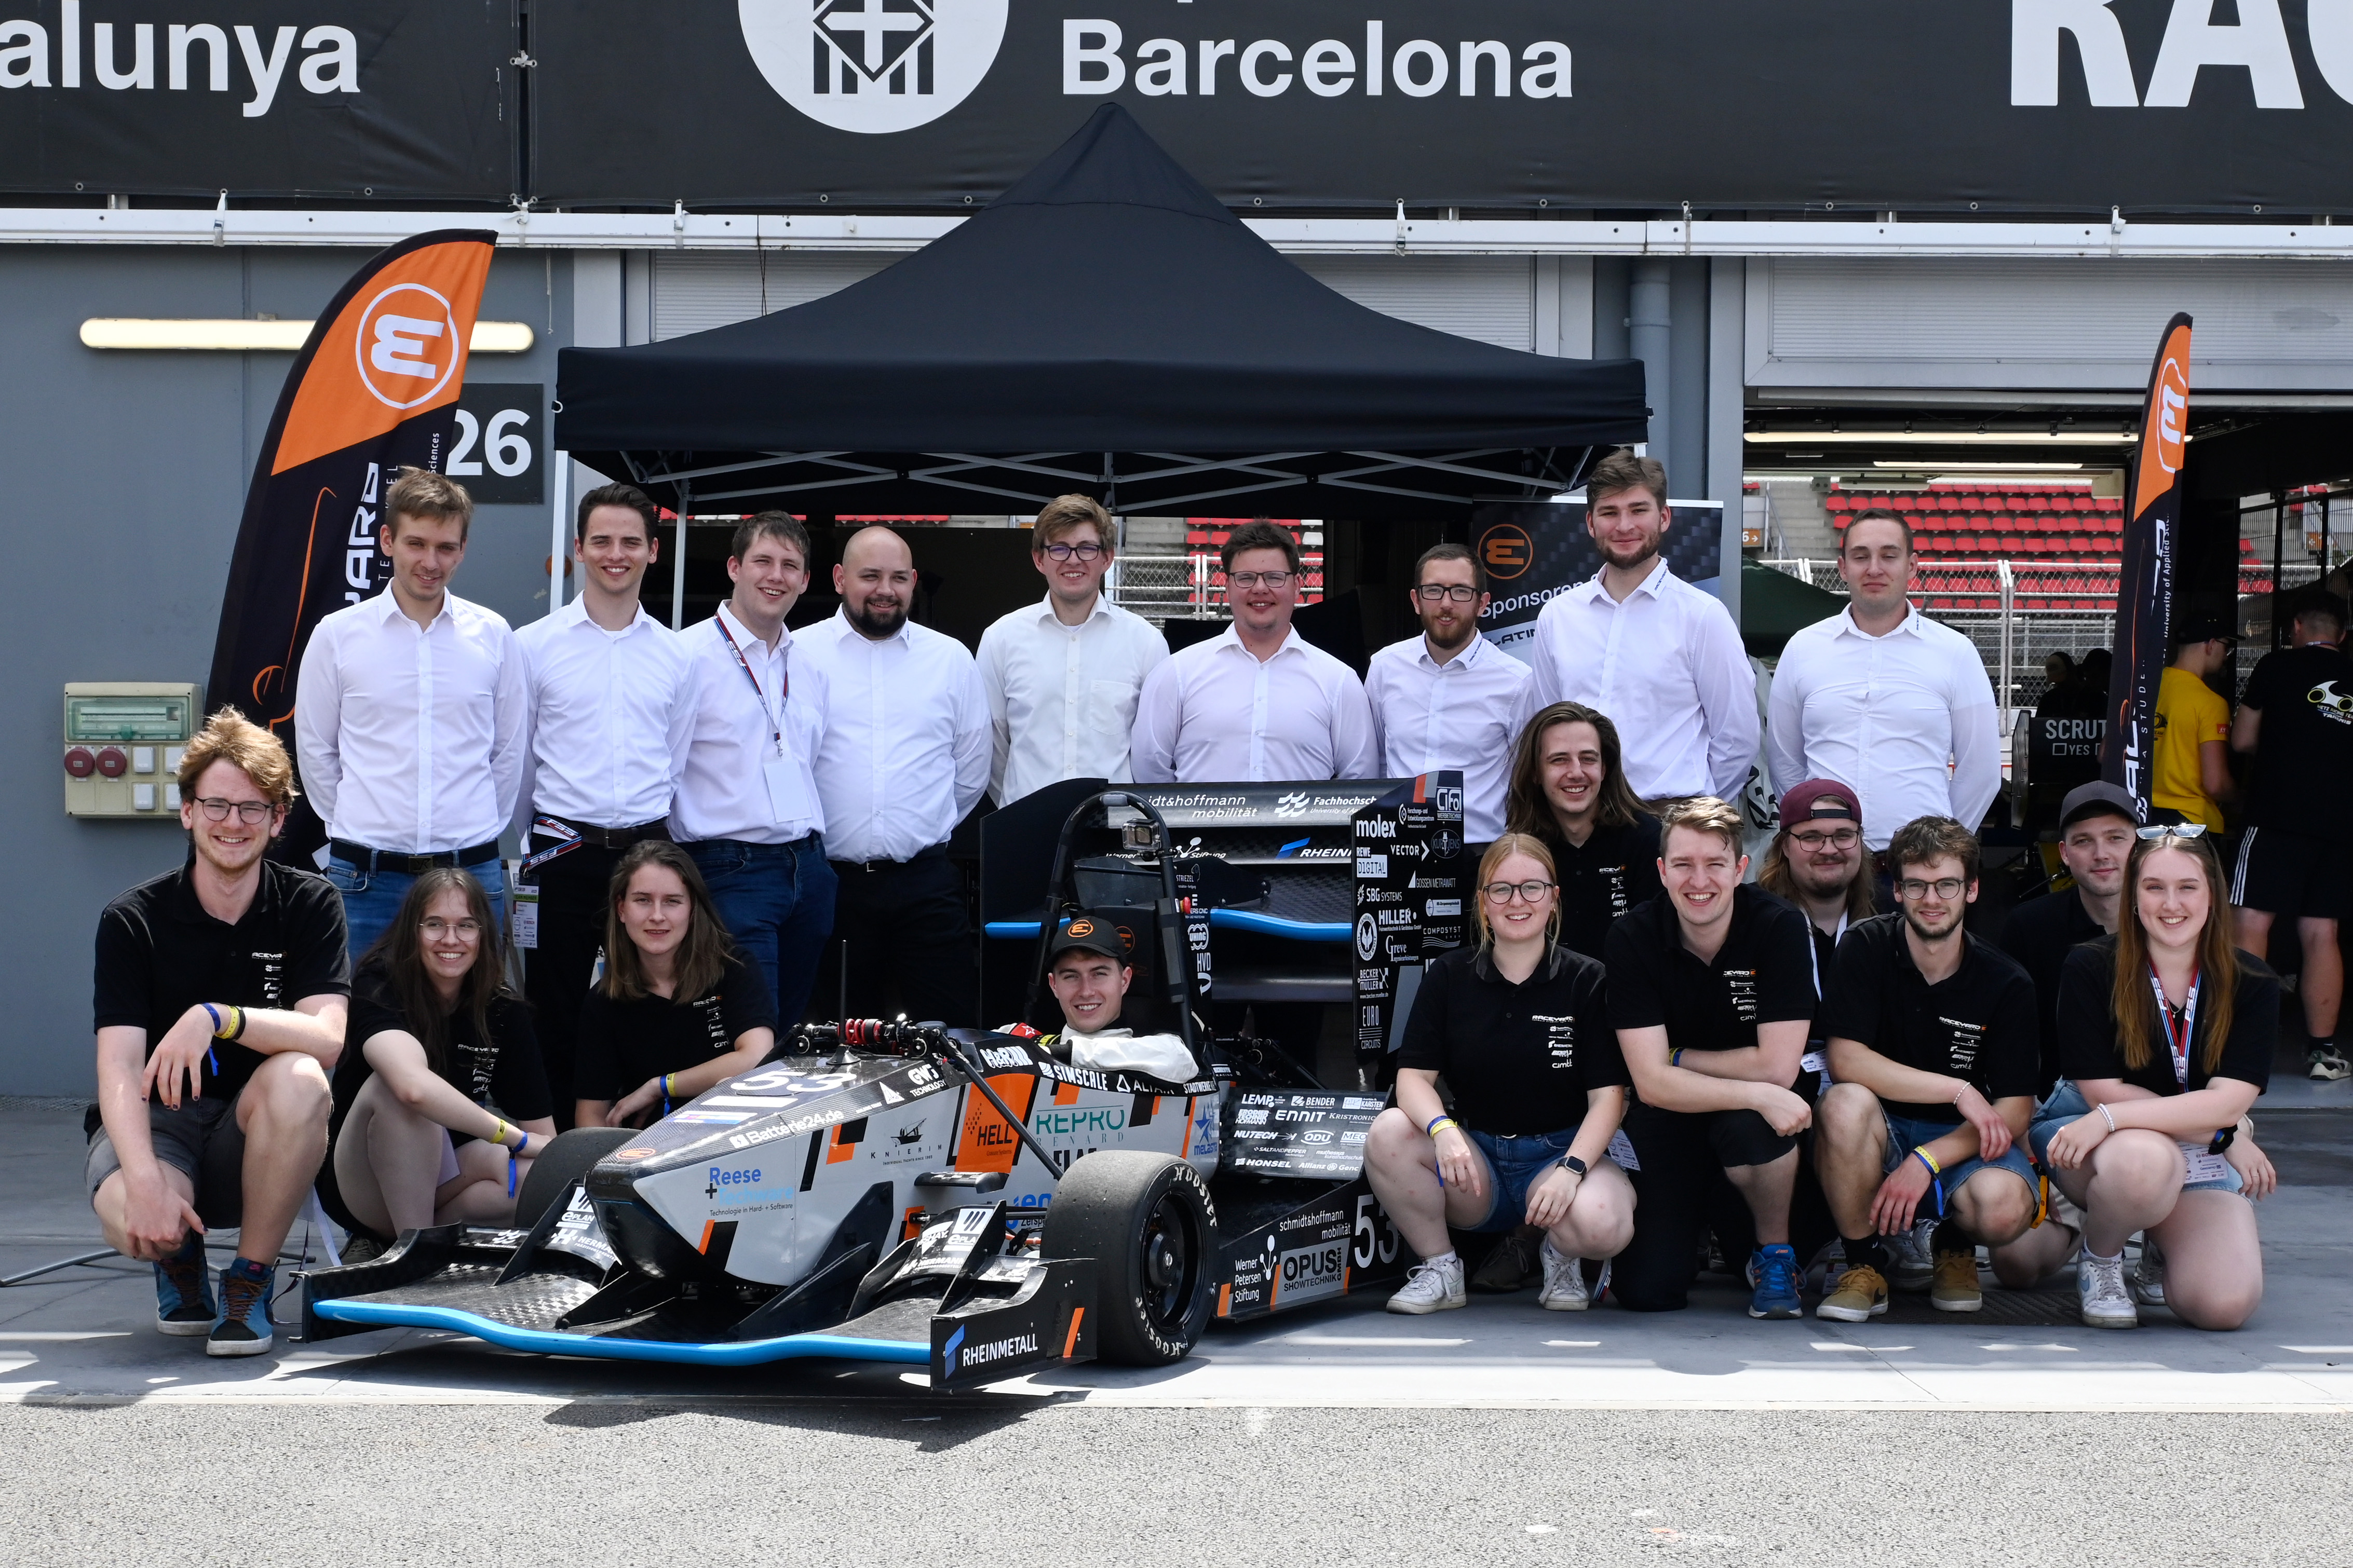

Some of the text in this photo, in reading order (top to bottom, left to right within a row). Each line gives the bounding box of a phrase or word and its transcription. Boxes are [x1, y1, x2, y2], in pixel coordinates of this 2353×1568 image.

[1063, 19, 1573, 98] Barcelona
[445, 408, 533, 477] 26
[2162, 540, 2172, 638] University of Applied
[2069, 744, 2090, 755] YES
[1192, 808, 1257, 819] mobilität
[1356, 814, 1396, 838] molex
[1356, 847, 1371, 857] REWE
[1390, 844, 1419, 856] VECTOR
[1416, 878, 1431, 888] GOSSEN
[1366, 888, 1402, 902] SBG SYSTEMS
[1378, 908, 1412, 925] HILLER
[1423, 926, 1461, 935] COMPOSYST
[1196, 952, 1211, 972] HVD
[1360, 969, 1379, 979] BECKER
[1362, 1005, 1380, 1027] EURO
[1939, 1016, 1981, 1030] RACEYARD
[1361, 1039, 1381, 1049] CIRCUITS
[730, 1070, 857, 1093] 53
[1053, 1065, 1108, 1091] SIMSCALE
[909, 1079, 947, 1097] TECHNOLOGY
[1305, 1097, 1335, 1106] BENDER
[746, 1108, 845, 1146] Batterie24.de
[977, 1123, 1013, 1147] HELL
[1234, 1130, 1278, 1140] NUTECH
[1304, 1134, 1331, 1142] ODU
[870, 1144, 942, 1160] KNIERIM
[1246, 1159, 1292, 1168] HONSEL
[709, 1167, 762, 1186] Reese
[718, 1185, 794, 1206] Techware
[710, 1207, 742, 1217] Technologie
[1279, 1210, 1344, 1232] schmidt&hoffmann
[1321, 1223, 1351, 1240] mobilität
[1354, 1193, 1399, 1269] 53
[1235, 1258, 1258, 1272] Werner
[1283, 1249, 1337, 1281] OPUS
[1235, 1273, 1261, 1287] Petersen
[1284, 1273, 1337, 1292] SHOWTECHNIK
[1235, 1288, 1260, 1303] Stiftung
[963, 1333, 1038, 1367] RHEINMETALL
